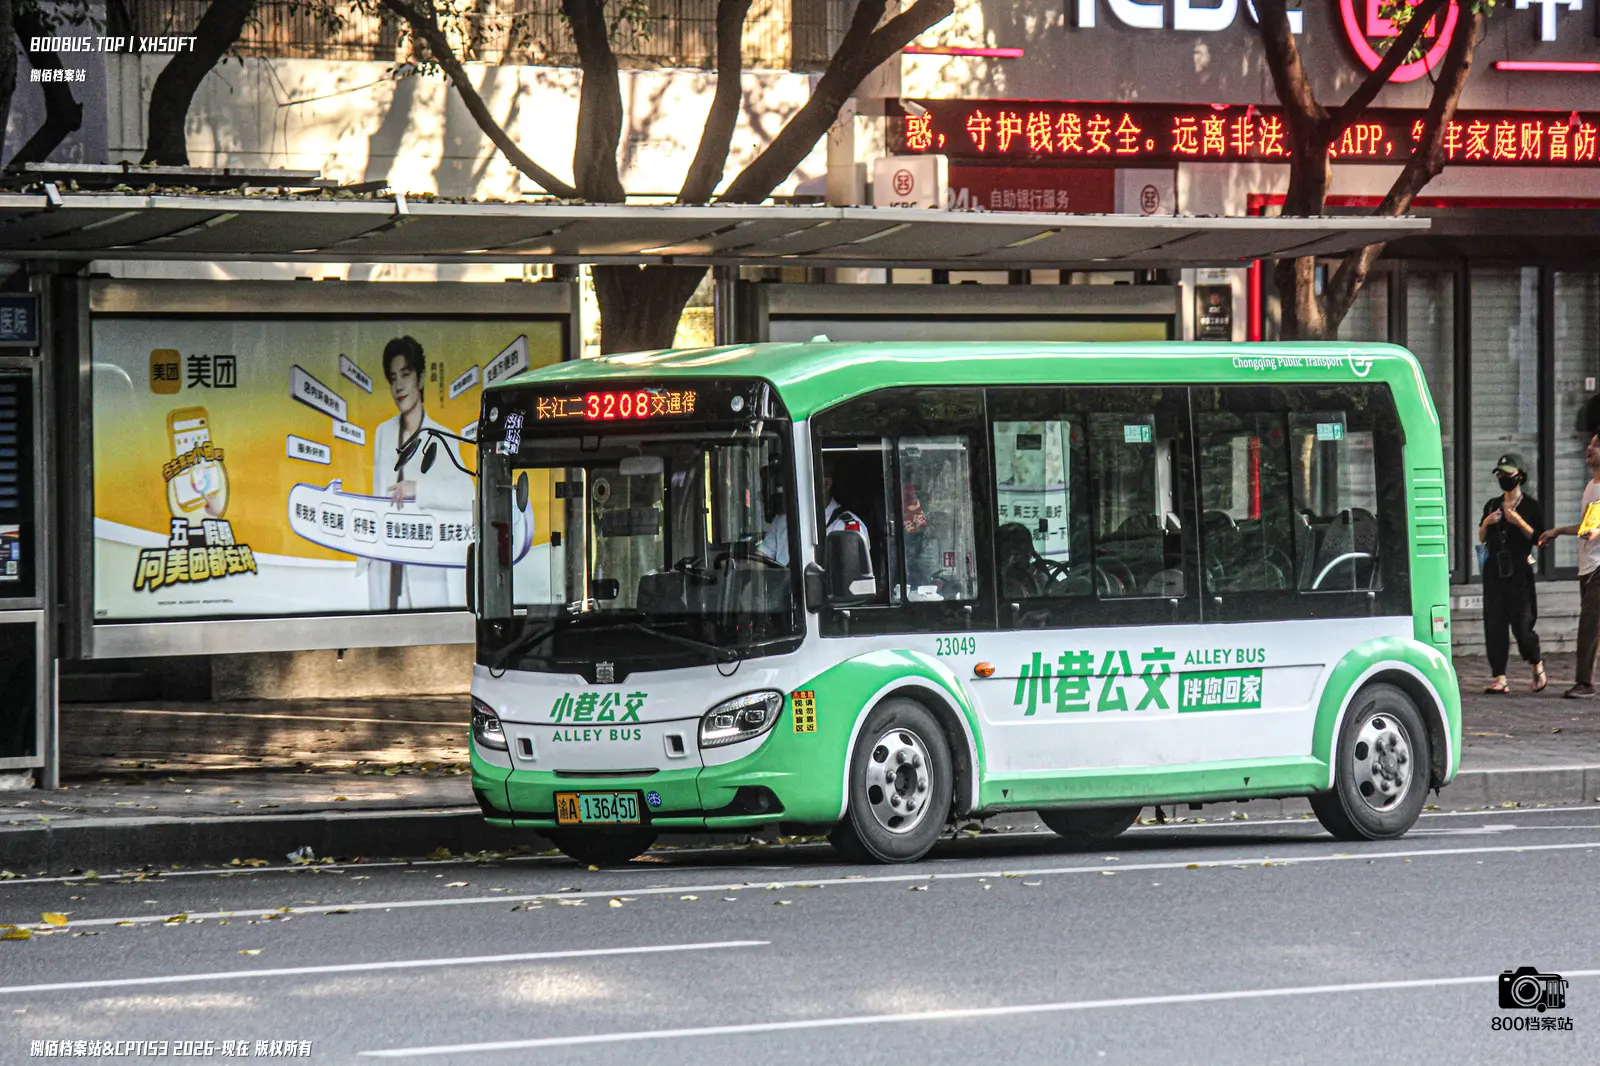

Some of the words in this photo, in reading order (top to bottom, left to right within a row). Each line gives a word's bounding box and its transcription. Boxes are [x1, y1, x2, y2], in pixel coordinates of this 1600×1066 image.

[990, 188, 1069, 210] 自助银行服务
[1, 308, 28, 333] 医院
[153, 363, 179, 380] 美团
[187, 354, 237, 388] 美团
[1232, 356, 1276, 370] Chongqing
[1278, 356, 1302, 367] Public
[1306, 356, 1343, 369] Transport
[587, 392, 648, 419] 3208
[1014, 505, 1039, 518] 两三天
[936, 637, 976, 656] 23049
[1184, 649, 1231, 665] ALLEY
[1236, 648, 1265, 663] BUS
[1013, 647, 1176, 716] 小巷公交
[1182, 675, 1261, 706] 伴您回家
[549, 691, 648, 723] 小巷公交
[552, 729, 602, 742] ALLEY
[610, 728, 642, 741] BUS
